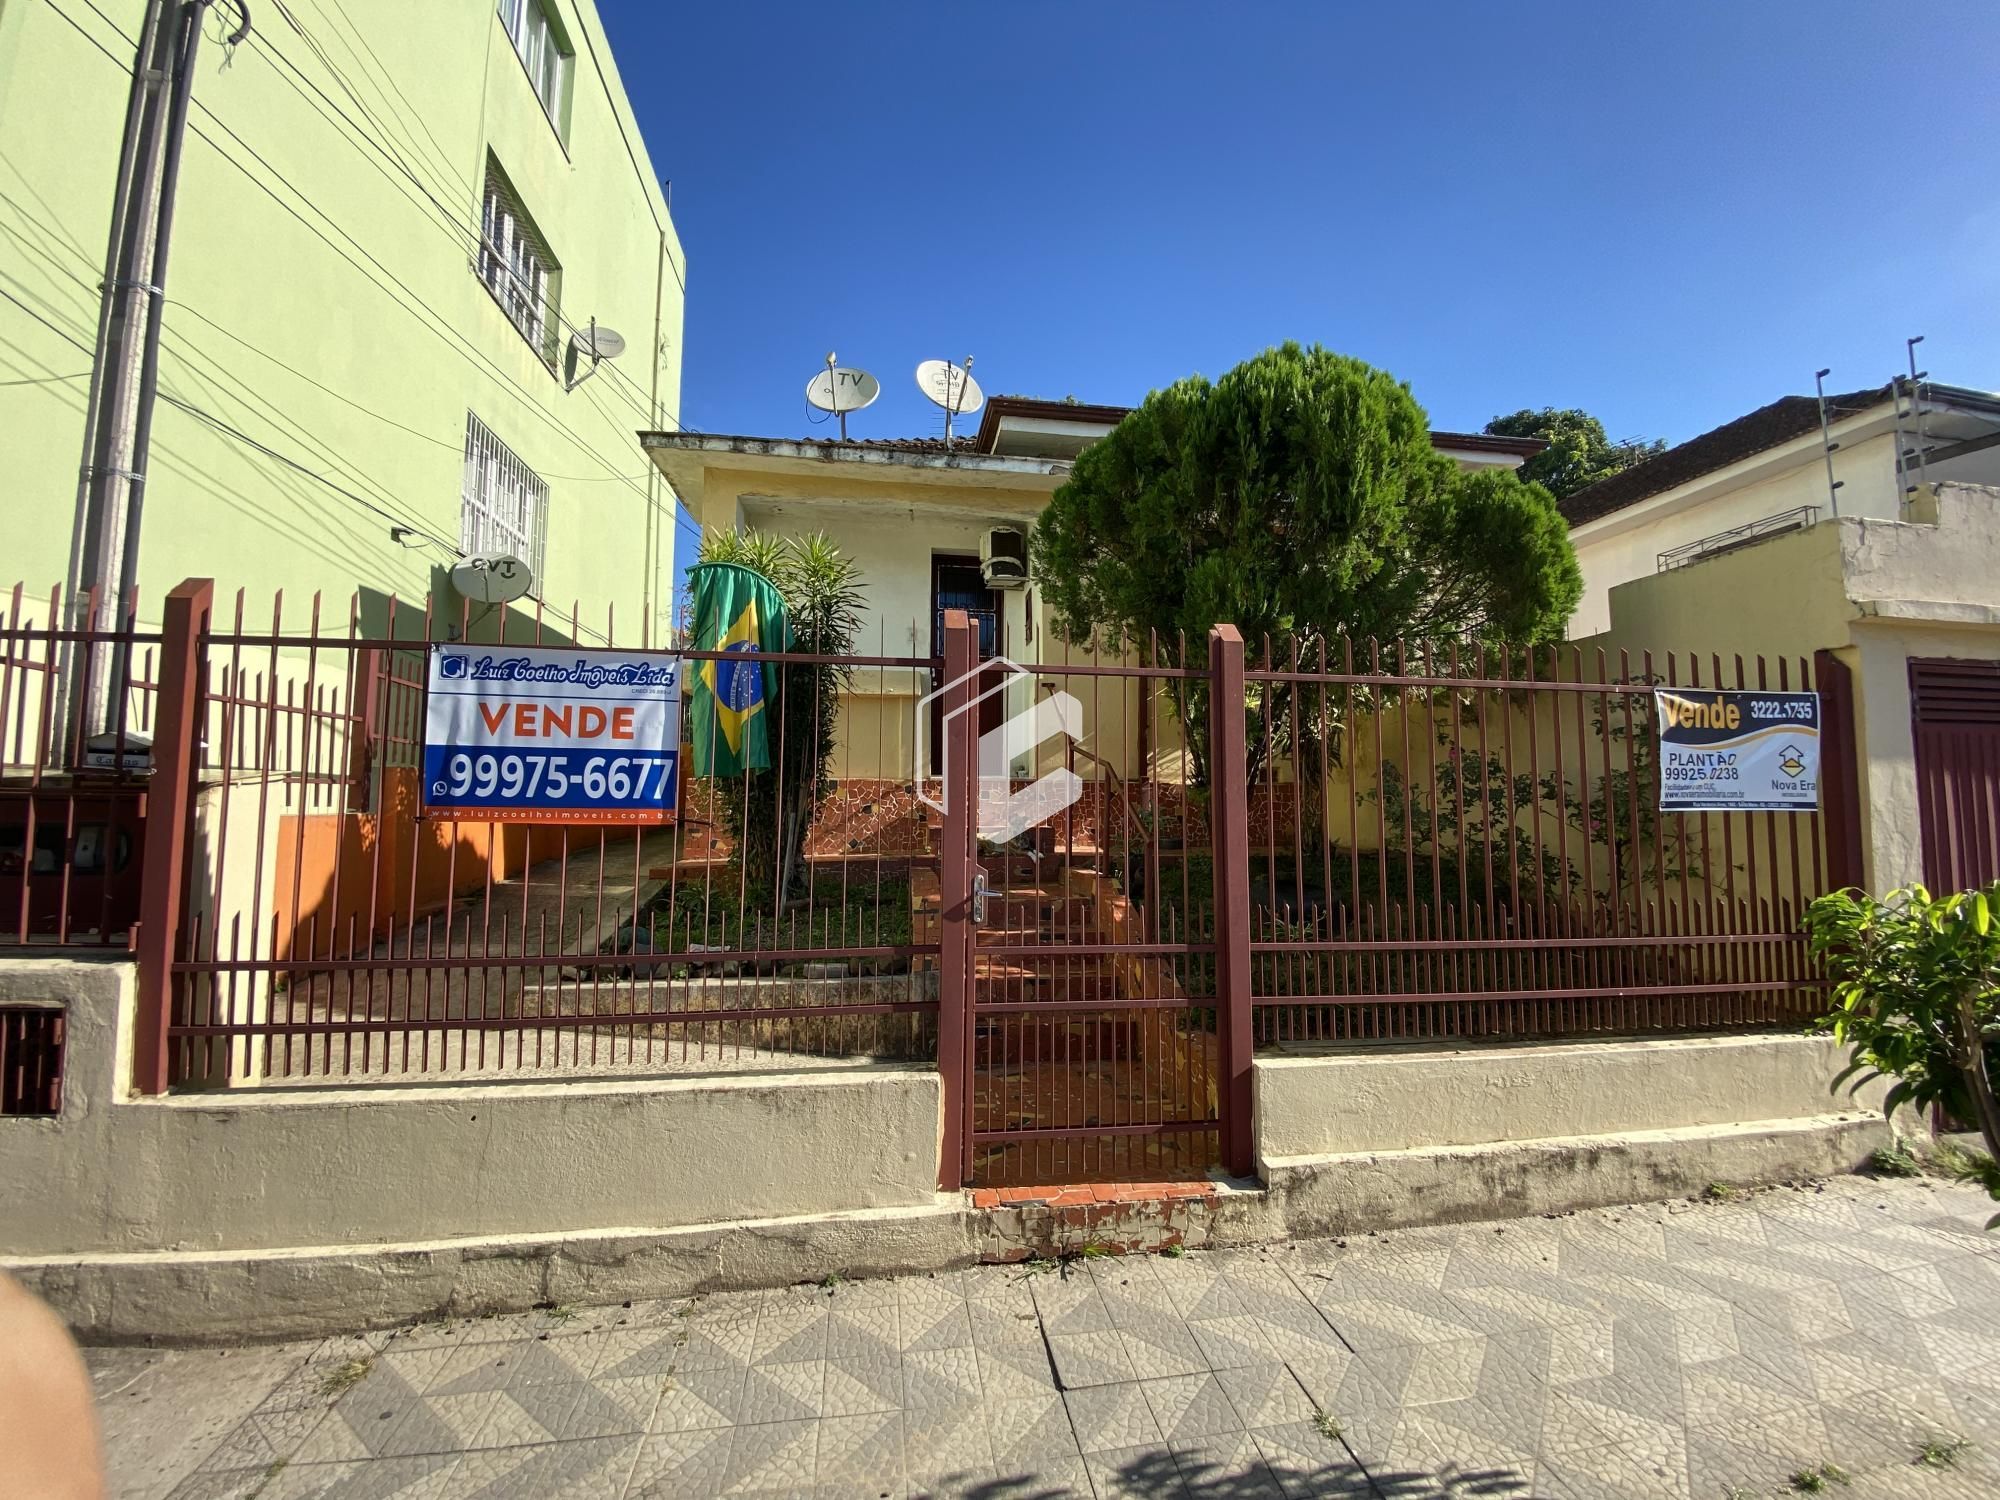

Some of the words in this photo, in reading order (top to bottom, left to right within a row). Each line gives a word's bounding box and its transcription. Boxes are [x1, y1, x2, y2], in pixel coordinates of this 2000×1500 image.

[838, 373, 864, 387] TV
[473, 656, 510, 679] Luiz
[505, 659, 567, 681] Coelho
[478, 702, 635, 740] VENDE
[1663, 696, 1741, 730] Vende
[1750, 700, 1813, 719] 3222.1755
[1669, 751, 1737, 767] PLANTÃO
[449, 753, 674, 800] 99975-6677
[1665, 767, 1739, 781] 99925.0238
[1771, 780, 1797, 791] Nova
[1800, 780, 1816, 791] Era
[431, 809, 671, 820] www.luizcoelhoimoveis.com.br
